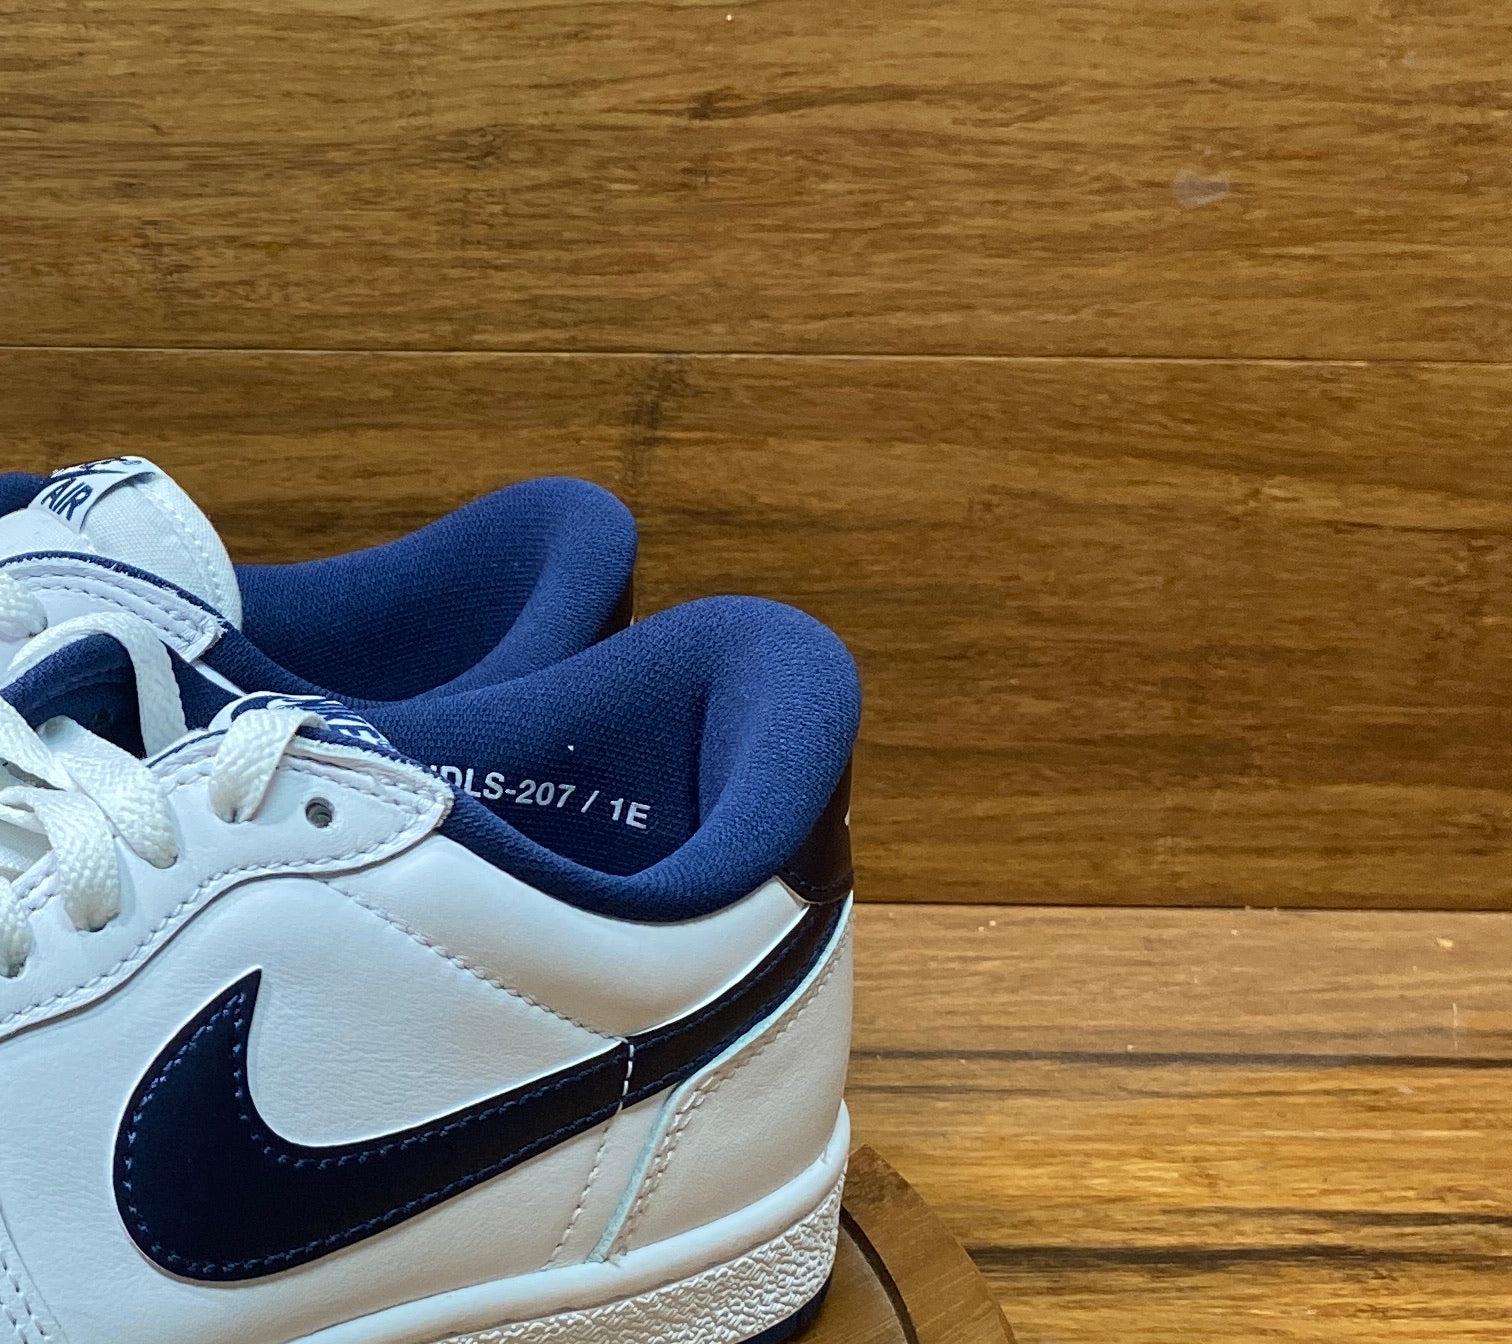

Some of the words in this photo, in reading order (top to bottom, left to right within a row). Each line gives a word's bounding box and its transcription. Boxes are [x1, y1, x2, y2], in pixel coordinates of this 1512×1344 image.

[40, 477, 93, 521] AIR
[430, 764, 577, 808] DLS-207
[610, 797, 651, 829] 1E
